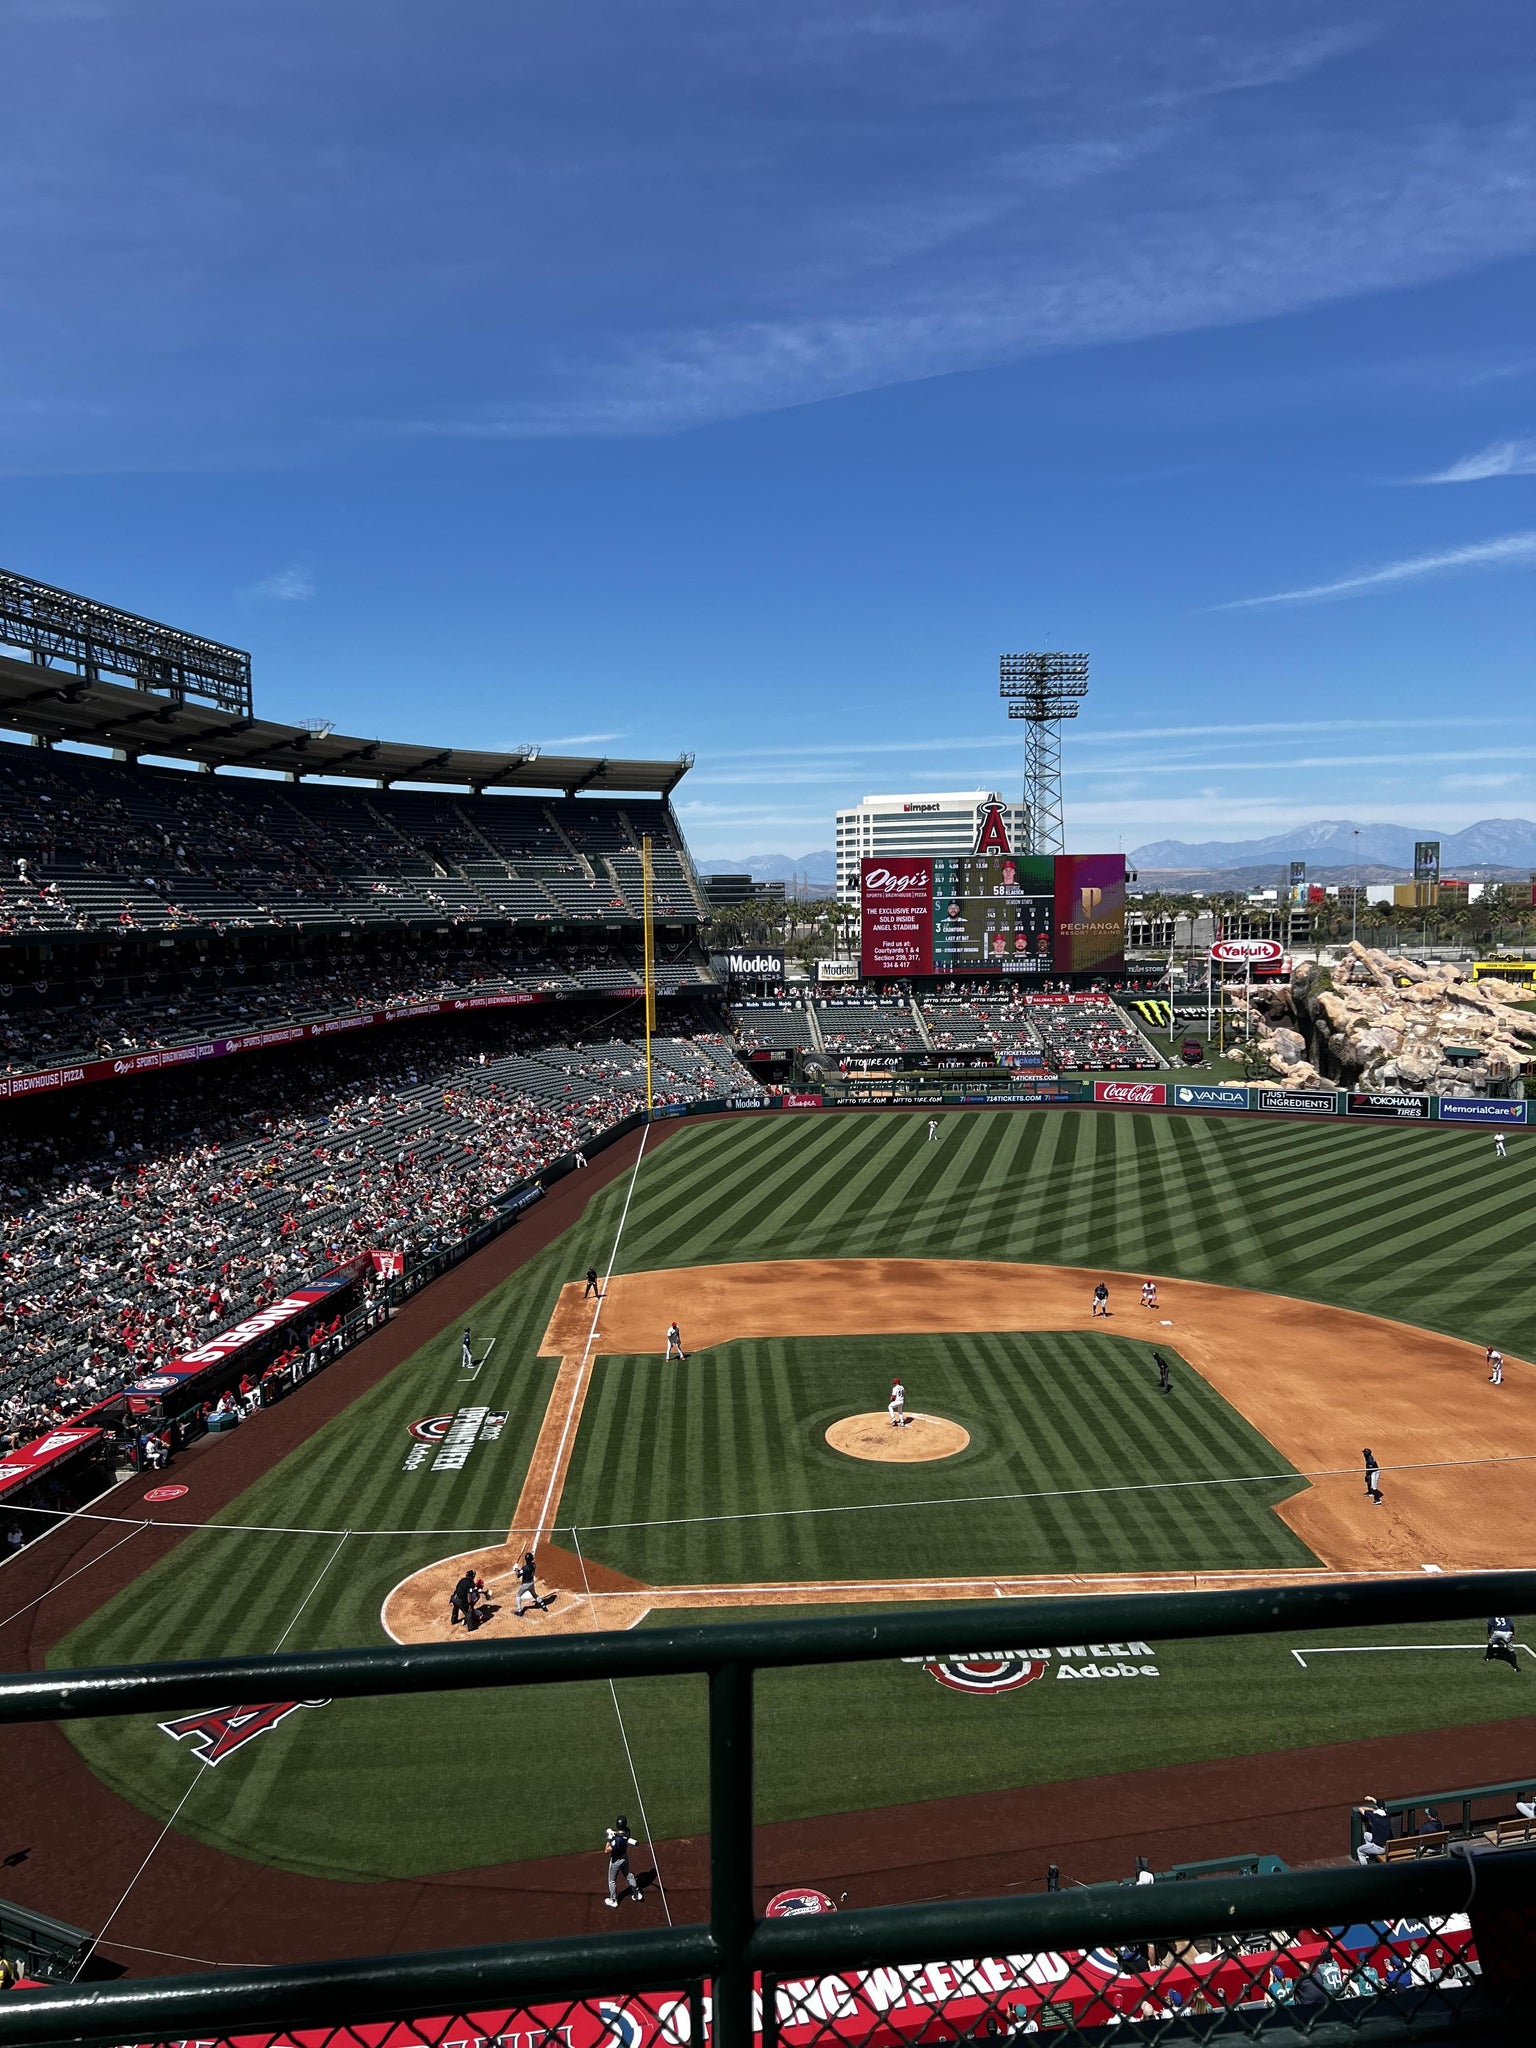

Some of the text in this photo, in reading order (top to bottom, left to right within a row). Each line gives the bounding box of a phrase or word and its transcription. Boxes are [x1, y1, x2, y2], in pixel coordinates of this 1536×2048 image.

[910, 803, 940, 812] impact
[865, 869, 929, 892] Oggi's
[994, 886, 1004, 895] 58
[936, 923, 941, 932] 3
[1222, 946, 1271, 956] Yakult
[730, 955, 781, 972] Modelo
[824, 964, 853, 975] Modelo
[488, 996, 517, 1004] BREWHOUSE
[114, 1045, 215, 1074] Oggi's SPORTS BREWHOUSE PIZZA
[13, 1073, 59, 1092] BREWHOUSE
[64, 1069, 84, 1082] PIZZA
[1104, 1083, 1155, 1102] Coca-Cola
[1194, 1090, 1244, 1101] VANDA
[736, 1098, 760, 1108] Modelo
[1266, 1098, 1329, 1108] INGREDIENTS
[1369, 1096, 1422, 1106] YOKOHAMA
[1444, 1105, 1510, 1115] MemorialCare
[181, 1299, 311, 1363] ANGELS
[431, 1407, 489, 1471] OPENING WEEK
[402, 1443, 431, 1471] Adobe
[1495, 1617, 1506, 1626] 53
[1056, 1662, 1160, 1679] Adobe
[1326, 1974, 1343, 1989] 44
[1365, 1982, 1373, 1992] 4
[658, 1951, 1071, 2046] ONING WEEKEND
